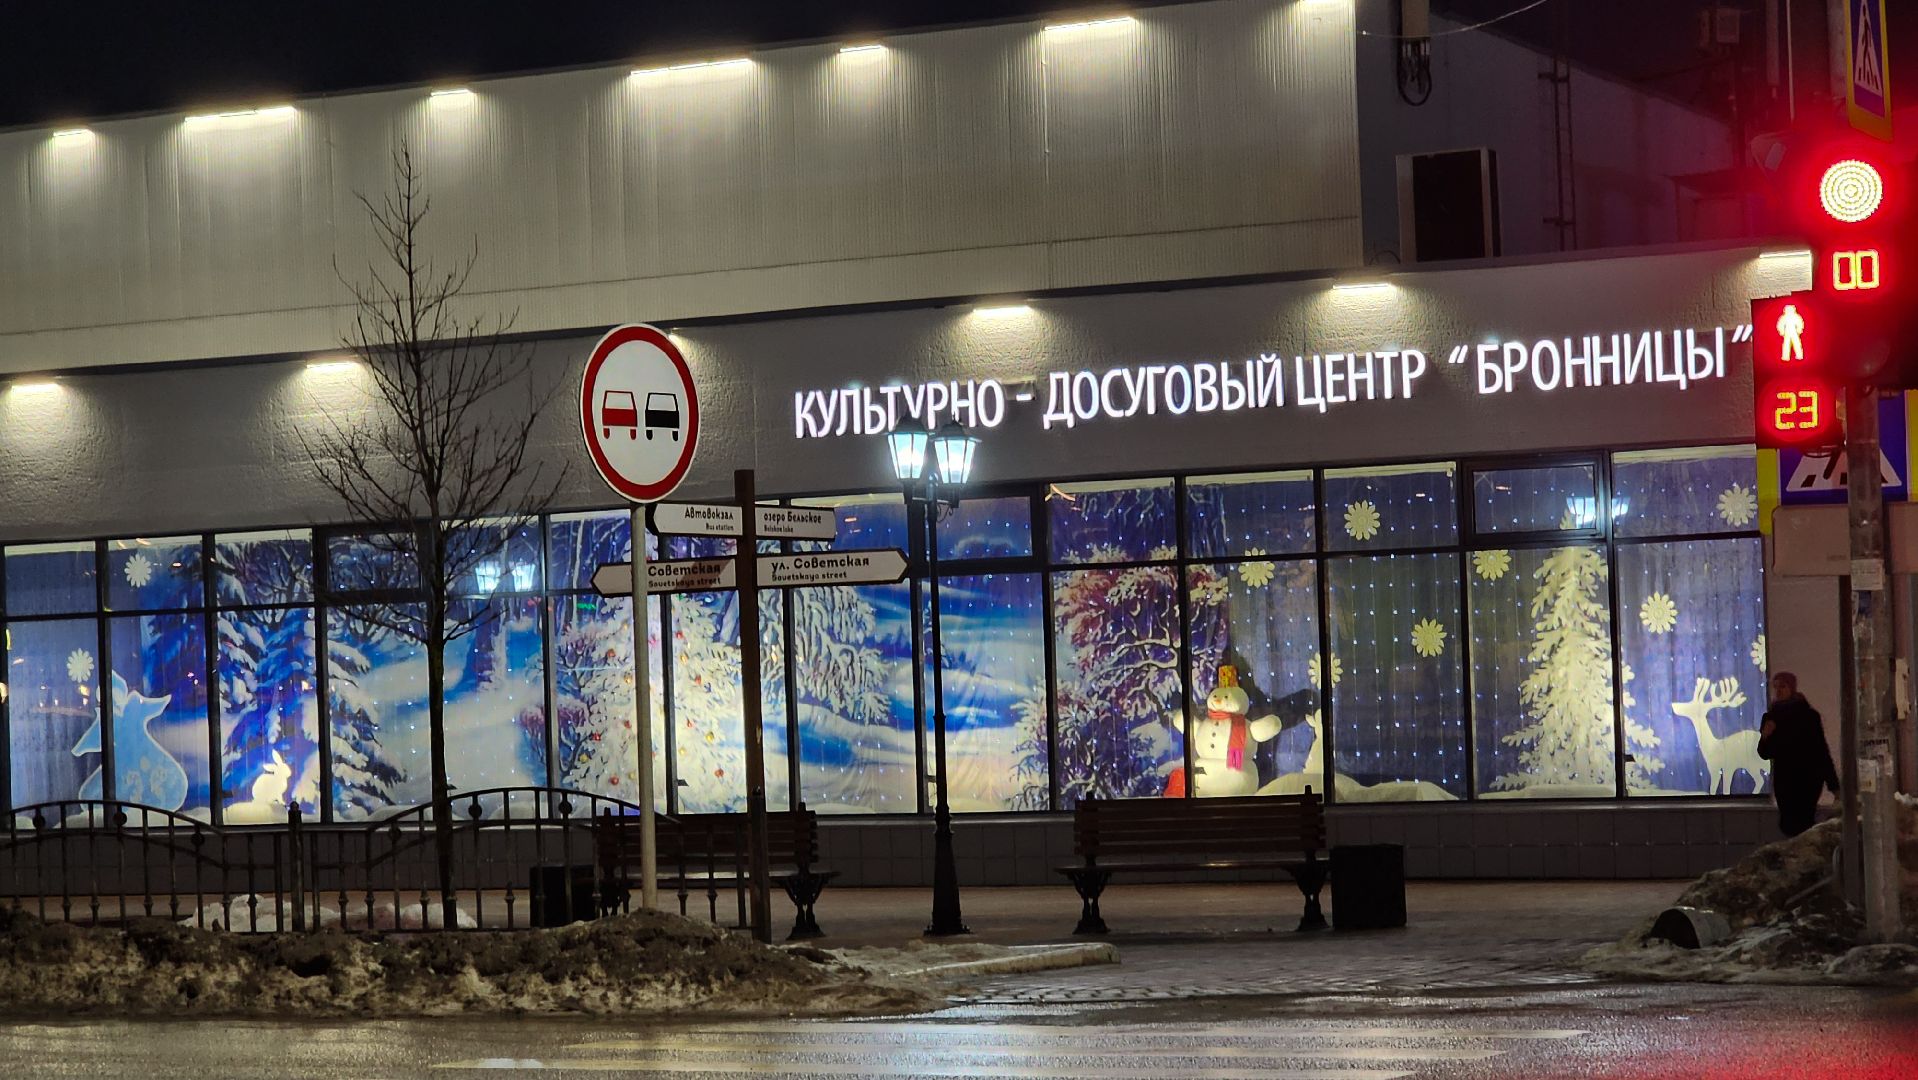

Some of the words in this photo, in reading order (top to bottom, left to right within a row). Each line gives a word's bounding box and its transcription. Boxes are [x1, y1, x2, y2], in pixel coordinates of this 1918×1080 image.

[1833, 249, 1880, 290] 00
[795, 379, 1005, 438] КУЛЬТУРНО
[1043, 353, 1285, 430] ДОСУГОВЫЙ
[1295, 349, 1426, 413] ЦЕНТР
[1775, 391, 1818, 430] 23
[685, 507, 734, 520] Автовокзал
[764, 511, 786, 524] озеро
[787, 511, 822, 524] Бельское
[648, 562, 720, 576] Советская
[772, 562, 790, 574] ул.
[794, 555, 869, 570] Советская
[697, 577, 721, 585] street
[821, 570, 847, 580] street
